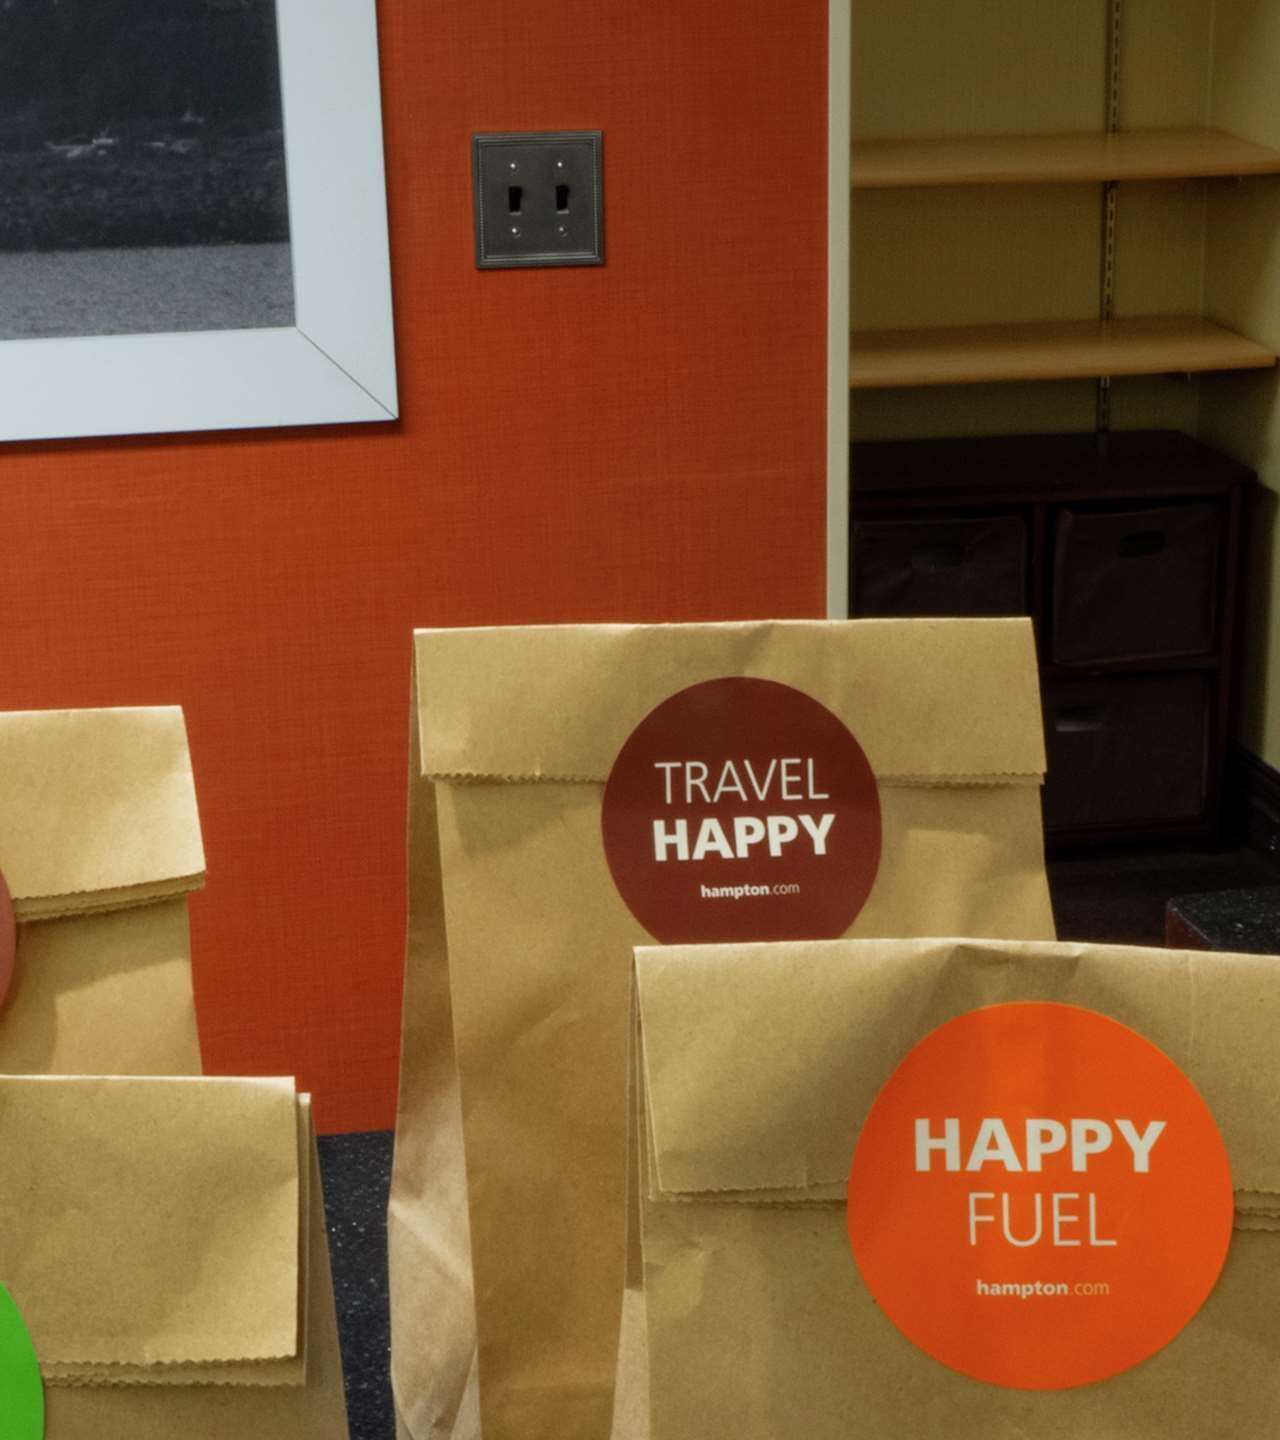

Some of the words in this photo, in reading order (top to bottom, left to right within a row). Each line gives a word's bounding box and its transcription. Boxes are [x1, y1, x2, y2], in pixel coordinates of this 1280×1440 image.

[654, 758, 830, 805] TRAVEL
[653, 813, 836, 862] HAPPY
[700, 883, 801, 900] hampton.com
[914, 1117, 1168, 1173] HAPPY
[968, 1192, 1118, 1247] FUEL
[976, 1278, 1111, 1299] hampton.com
